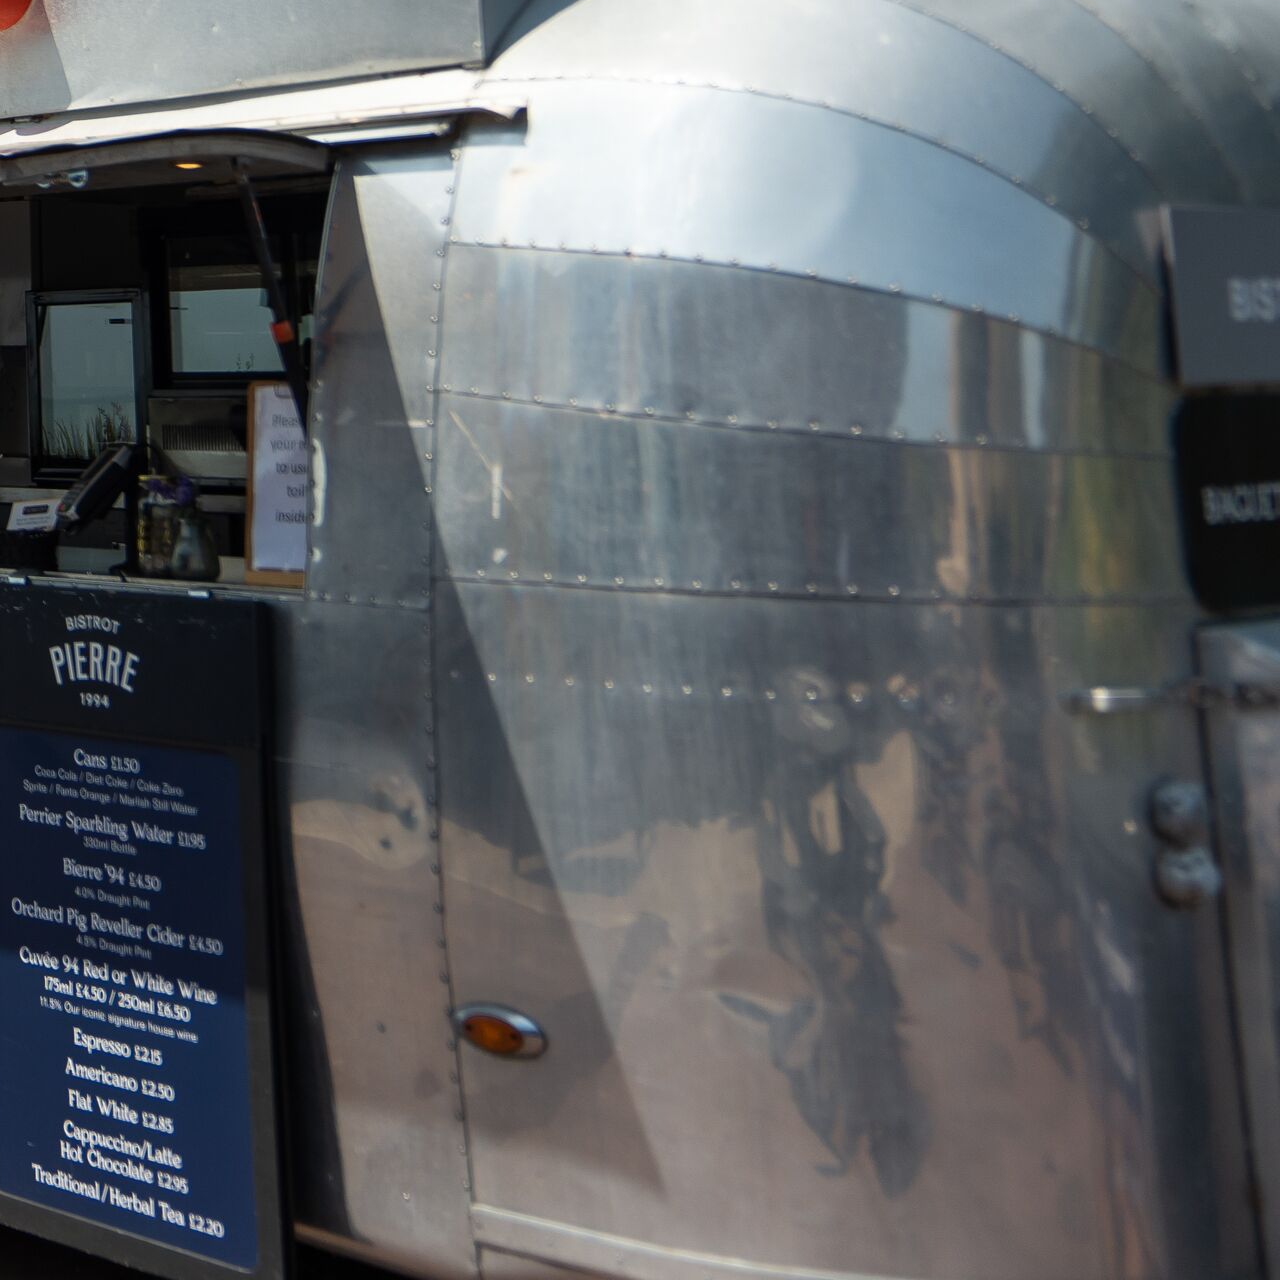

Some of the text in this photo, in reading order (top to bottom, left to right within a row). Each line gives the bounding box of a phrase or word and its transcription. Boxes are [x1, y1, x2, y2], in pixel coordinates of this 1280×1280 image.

[287, 483, 305, 497] toil
[275, 510, 305, 523] insid
[65, 614, 120, 634] BISTROT
[49, 641, 140, 693] PIERRE
[80, 692, 110, 709] 1994
[34, 764, 57, 779] Coca
[58, 767, 79, 782] Cola
[85, 771, 104, 784] Diet
[105, 774, 128, 788] Coke
[137, 779, 160, 793] Coke
[162, 782, 184, 797] Zero
[73, 748, 141, 774] Cans £1.50
[23, 779, 47, 794] Sprite
[55, 784, 79, 798] Fanta
[79, 787, 110, 805] Orange
[152, 797, 170, 811] Still
[170, 800, 198, 815] Water
[19, 803, 206, 850] Perrier Sparkling Water £1.95
[83, 836, 137, 856] 330ml Bottle
[63, 857, 103, 881] Bierre
[128, 872, 162, 892] £4.50
[75, 886, 151, 911] 4.0% Draught Pint
[11, 897, 224, 955] Orchard Pig Reveller Cider £4.50
[99, 938, 133, 956] Draught
[134, 945, 153, 960] Pint
[20, 946, 218, 1005] Cuvée 94 Red or White Wine
[40, 995, 63, 1012] 11.5%
[64, 1000, 80, 1015] Our
[81, 1006, 106, 1022] iconic
[107, 1012, 146, 1029] signature
[148, 1020, 176, 1037] house
[44, 976, 192, 1023] 175ml £4.50 / 250ml £6.50
[73, 1026, 163, 1066] Espresso £2.15
[65, 1057, 176, 1102] Americano £2.50
[68, 1088, 174, 1134] Flat White £2.85
[63, 1119, 183, 1170] Cappuccino/Latte
[60, 1139, 189, 1195] Hot Chocolate £2.95
[158, 1200, 186, 1227] Tea
[188, 1212, 225, 1239] £2.20
